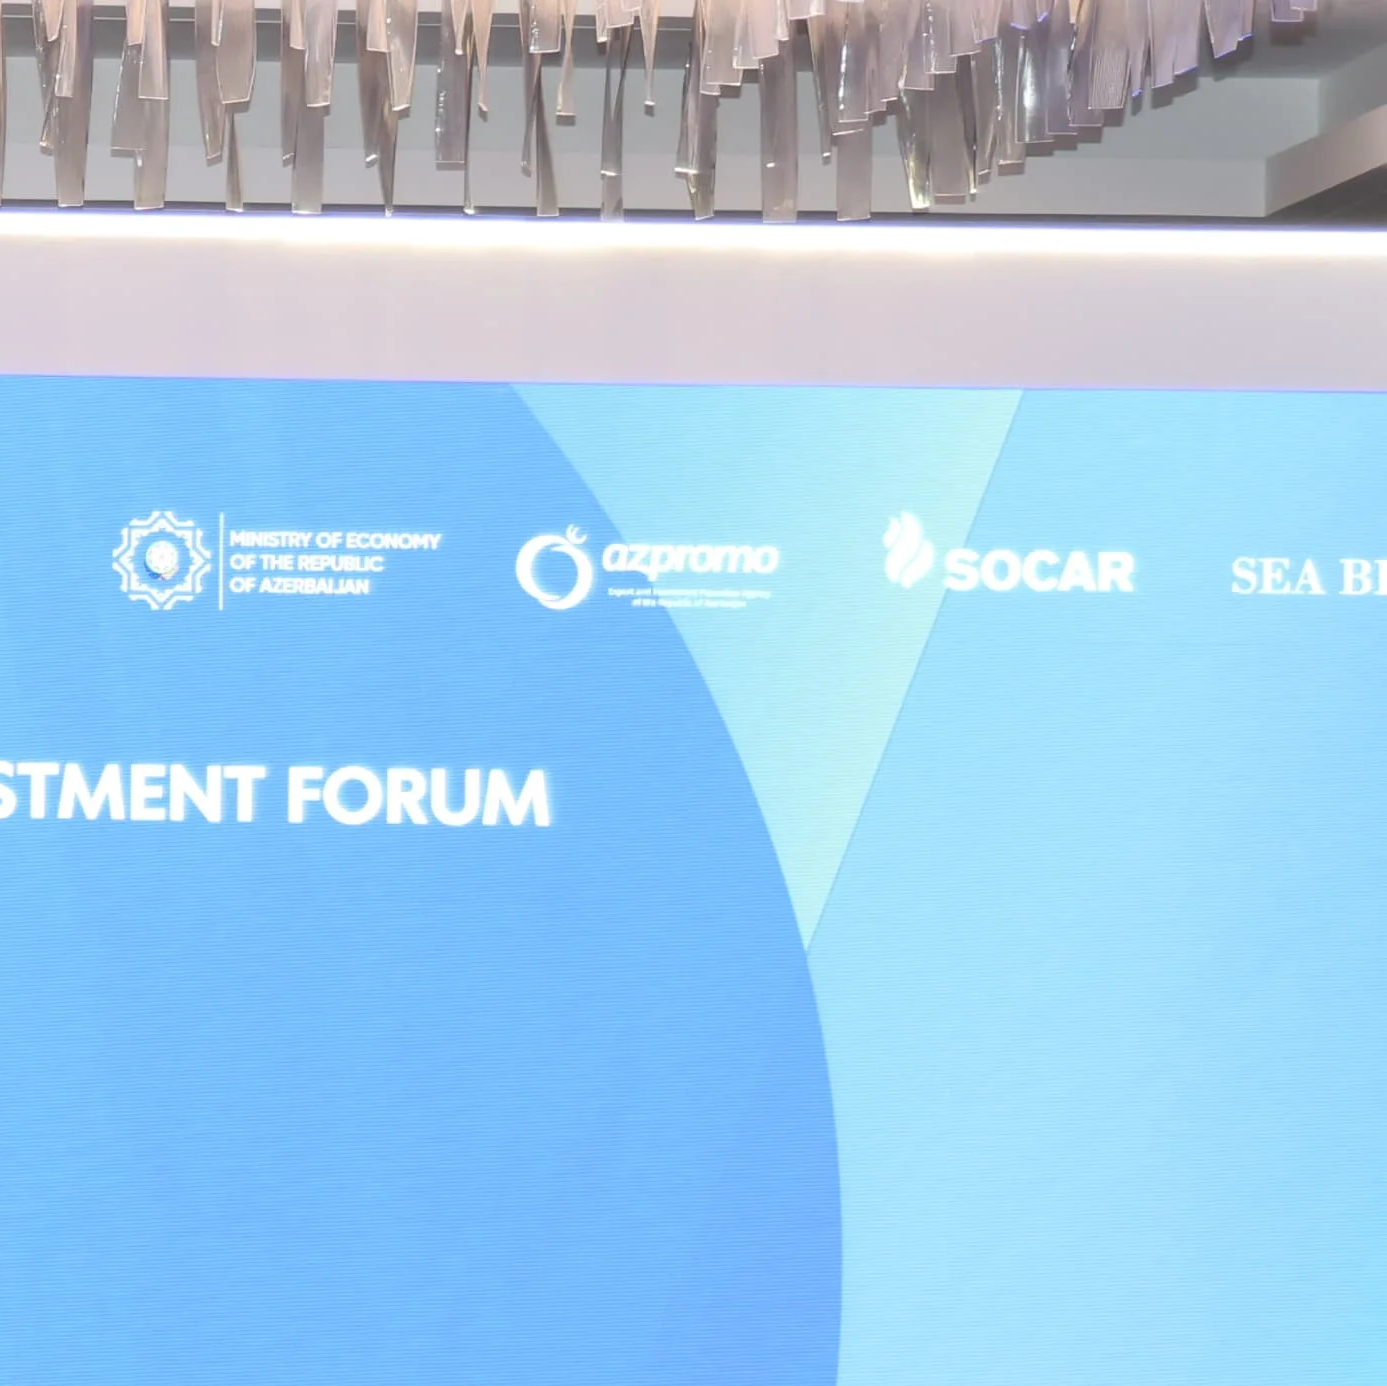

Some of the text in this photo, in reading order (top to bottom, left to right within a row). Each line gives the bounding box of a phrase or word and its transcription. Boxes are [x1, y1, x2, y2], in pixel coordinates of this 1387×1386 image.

[229, 530, 442, 550] MINISTRY OF ECONOMY
[229, 553, 385, 573] OF THE REPUBLIC
[601, 542, 781, 582] azpromo
[943, 548, 1135, 592] SOCAR
[1231, 556, 1327, 596] SEA
[229, 576, 371, 596] OF AZERBAIJAN
[288, 765, 552, 828] FORUM
